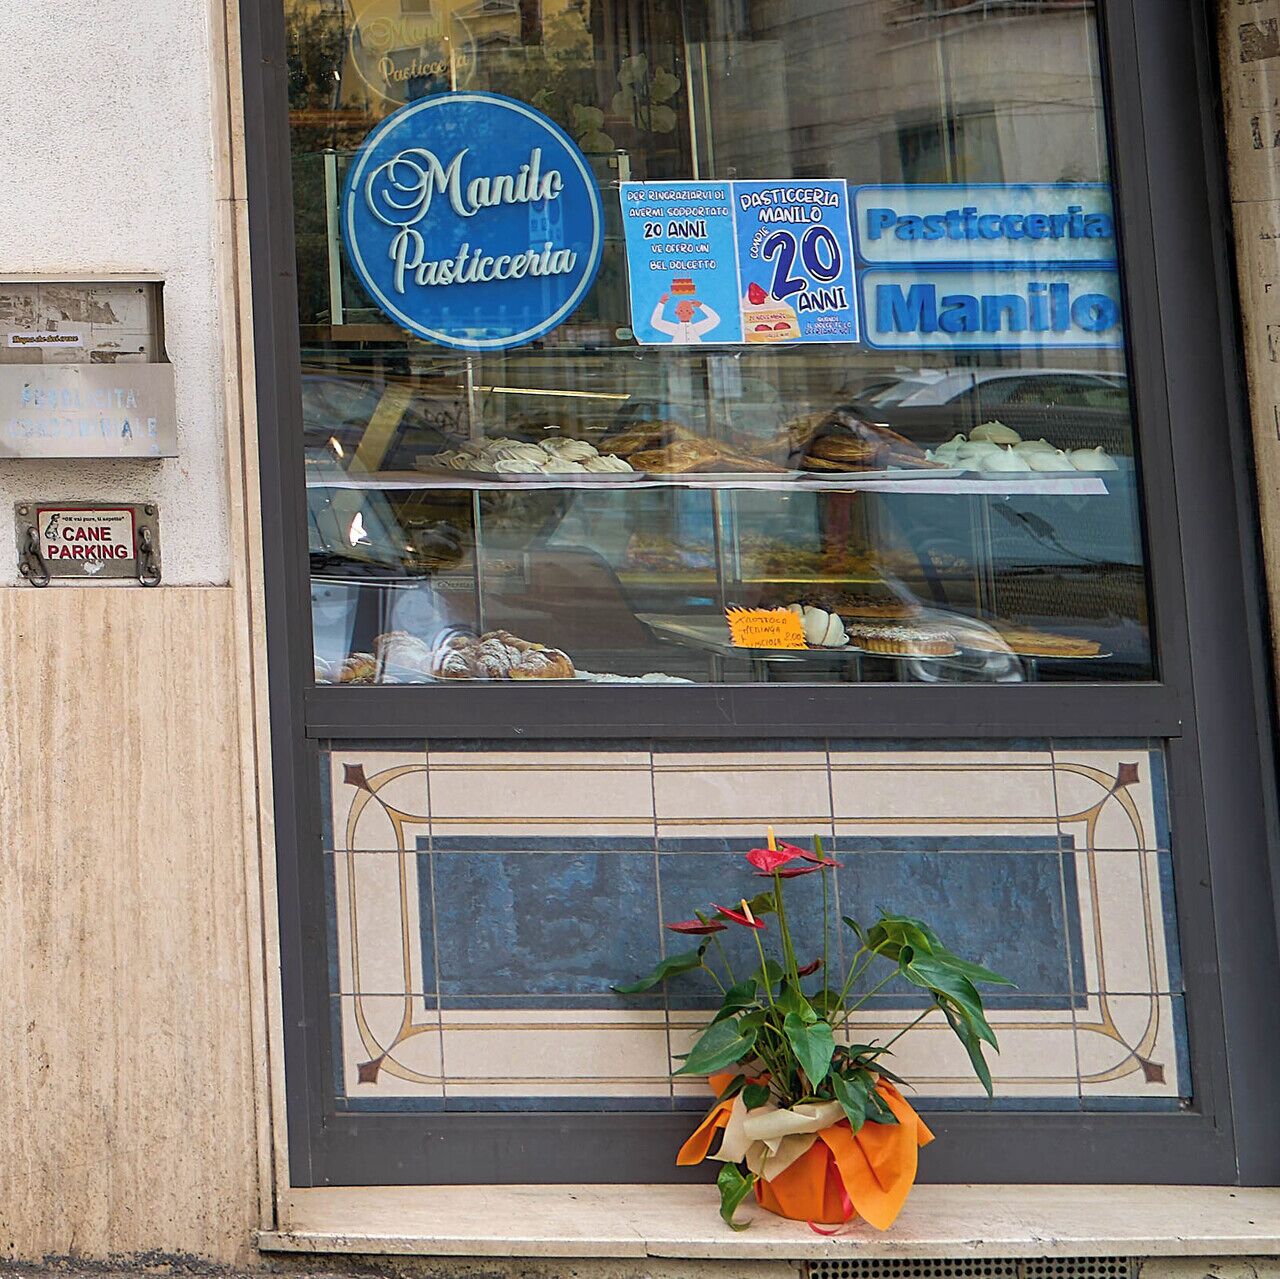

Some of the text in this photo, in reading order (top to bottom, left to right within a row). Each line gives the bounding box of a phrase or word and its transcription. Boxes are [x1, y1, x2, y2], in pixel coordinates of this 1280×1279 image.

[365, 148, 564, 226] Manilo
[648, 190, 712, 201] RINGRAZIARVI
[714, 190, 725, 200] DI
[740, 188, 839, 210] PASTICCERIA
[629, 207, 729, 217] AVERMI SOPPORTATO
[759, 207, 822, 223] MANILO
[644, 220, 708, 239] 20 ANNI
[867, 206, 1115, 241] Pasticceria
[665, 244, 694, 253] OFFRO
[389, 227, 577, 295] Pasticceria
[650, 260, 716, 270] BEL DOLCETTO
[762, 224, 843, 301] 20
[798, 287, 848, 312] ANNI
[876, 283, 1120, 333] Manilo
[62, 527, 112, 541] CANE
[47, 544, 128, 560] PARKING
